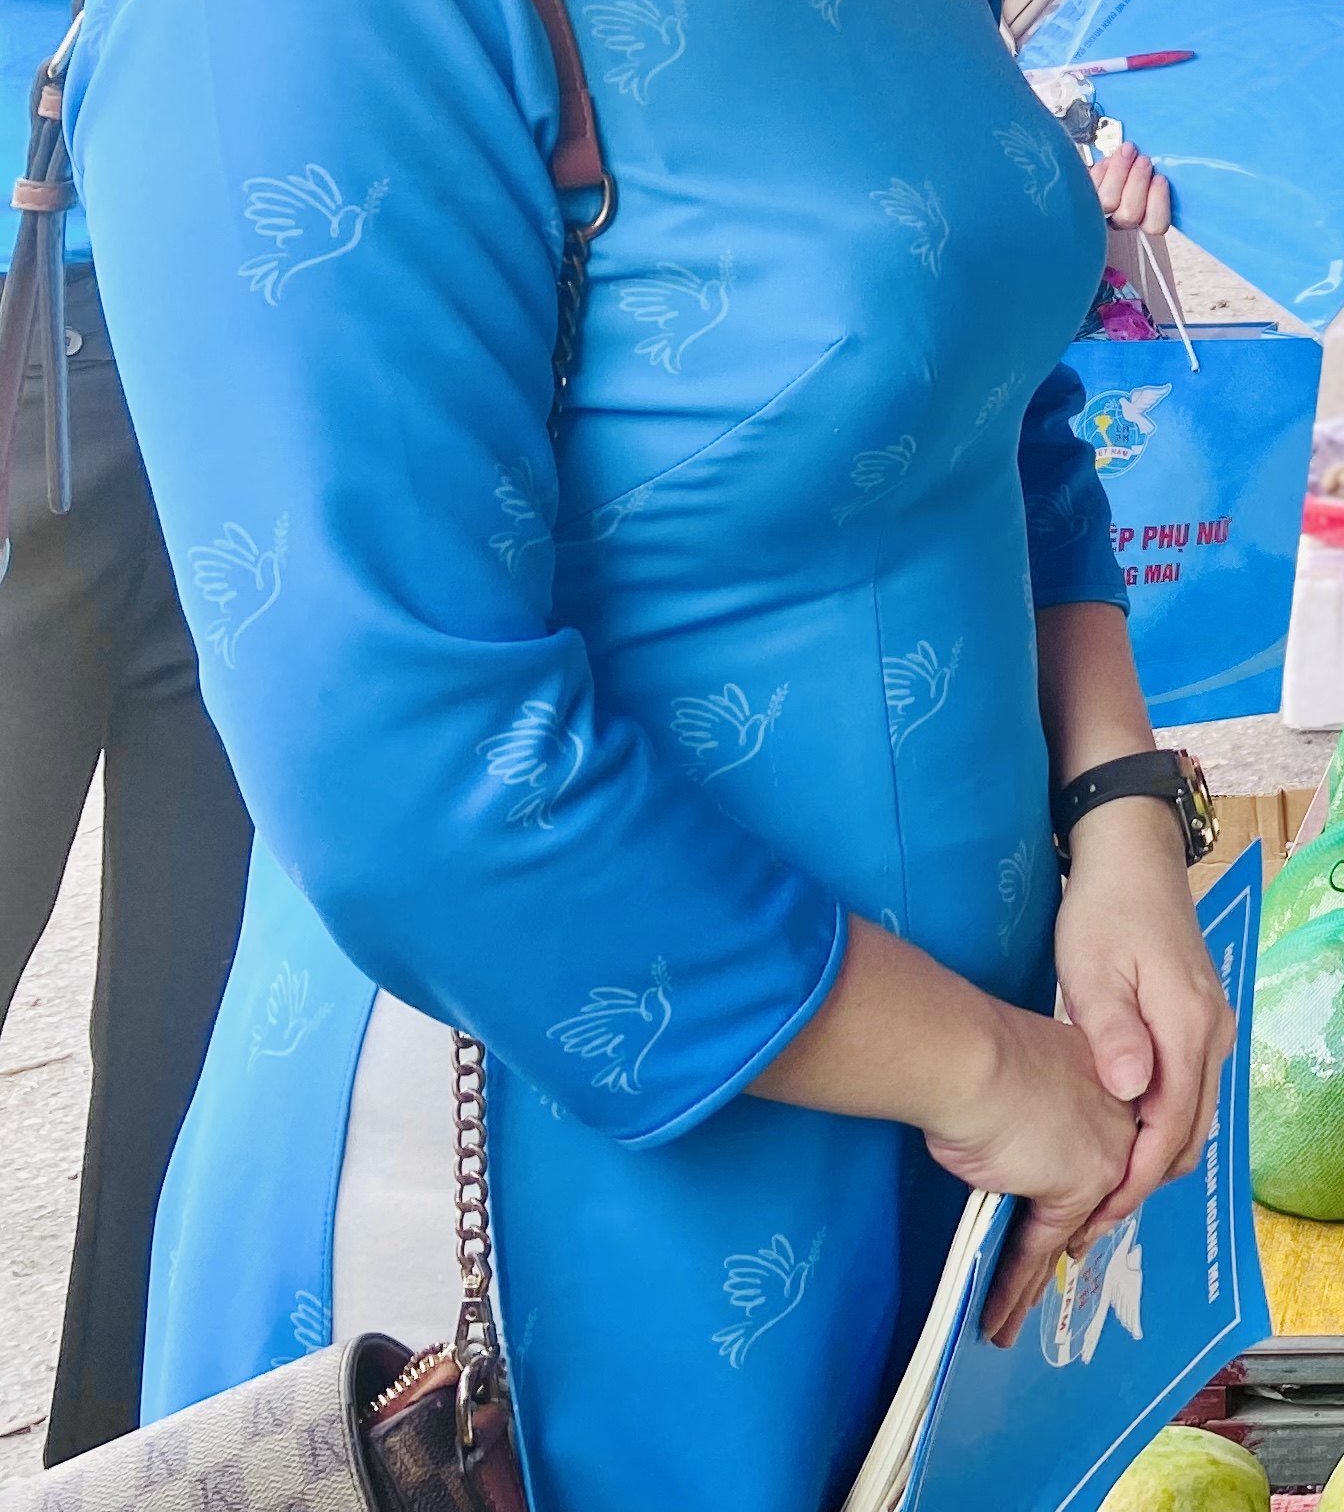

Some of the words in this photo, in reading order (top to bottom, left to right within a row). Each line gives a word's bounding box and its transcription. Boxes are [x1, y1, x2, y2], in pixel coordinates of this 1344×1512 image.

[1142, 522, 1190, 553] PHỤ
[1197, 515, 1233, 545] NỮ
[1144, 562, 1180, 585] MAI
[1205, 1140, 1220, 1197] QUẬN
[1206, 1194, 1220, 1264] HOÀNG
[1207, 1261, 1220, 1304] MAI
